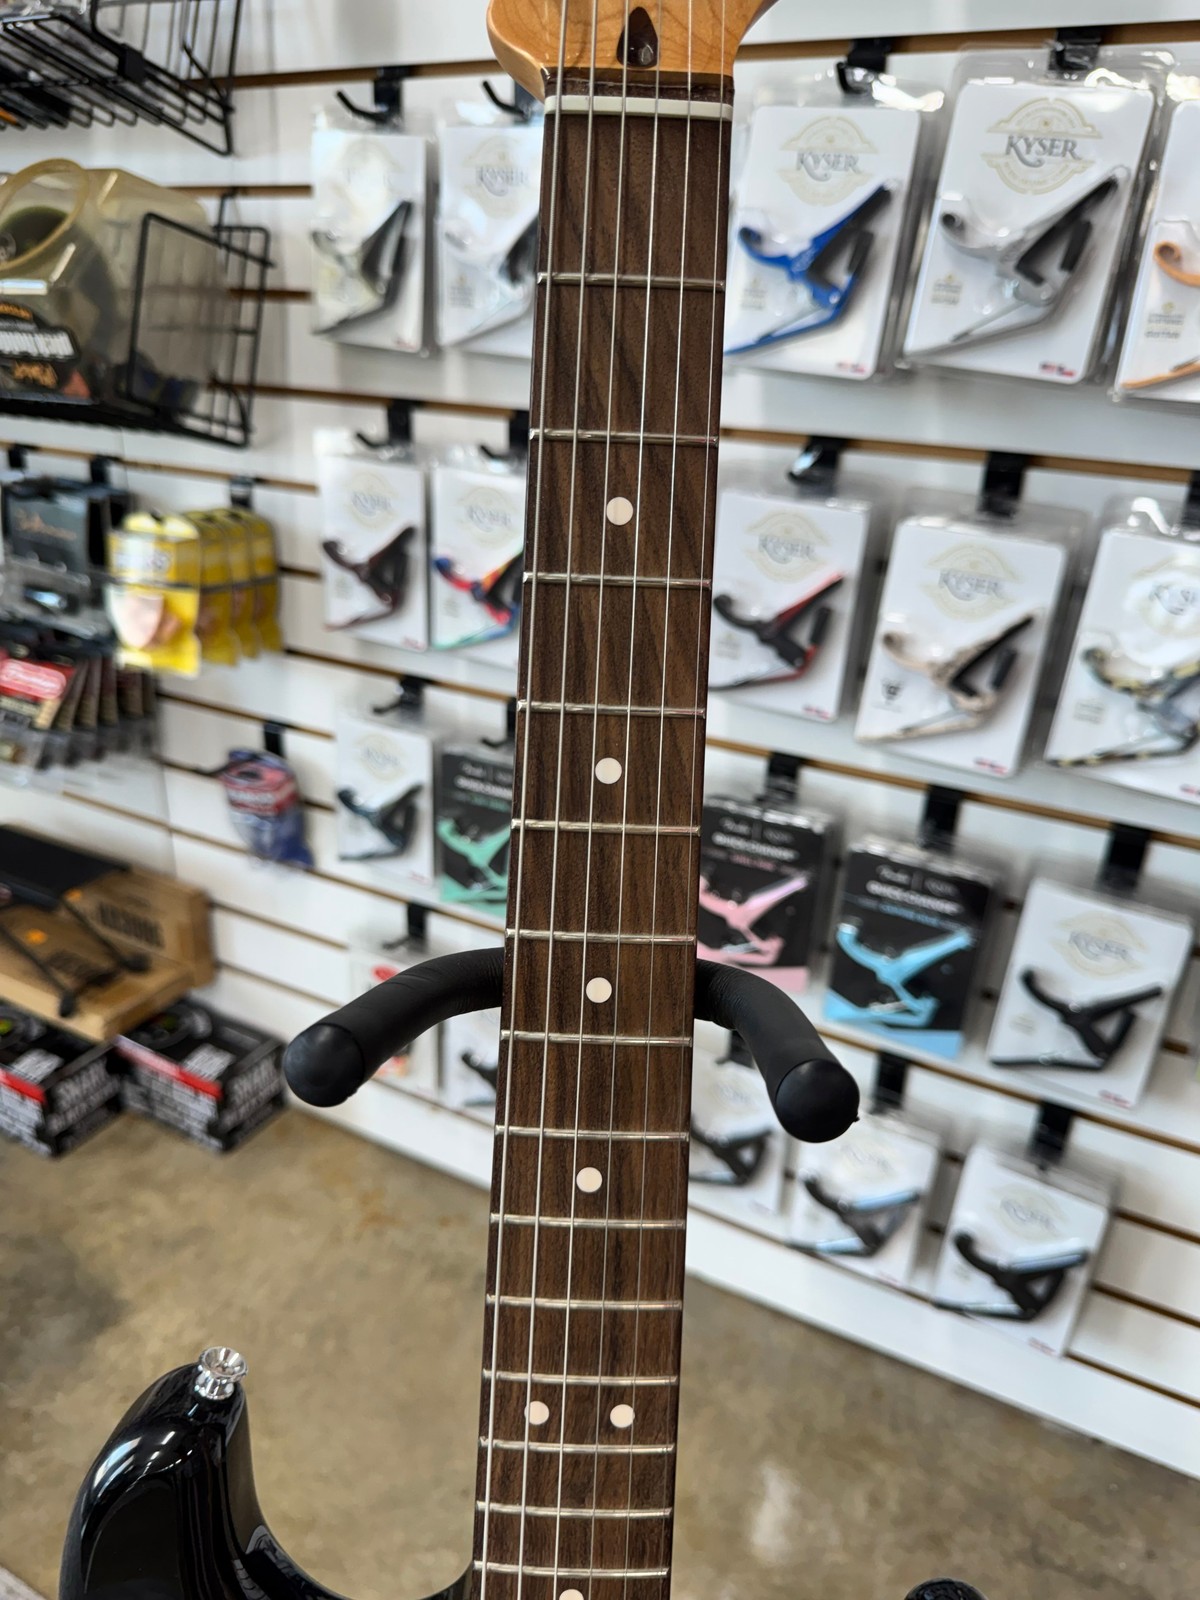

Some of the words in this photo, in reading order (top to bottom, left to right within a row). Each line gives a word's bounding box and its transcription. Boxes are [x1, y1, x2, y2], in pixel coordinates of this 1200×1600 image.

[796, 152, 863, 182] KYSER
[1005, 135, 1082, 167] KYSER
[938, 569, 1006, 602] KYSER
